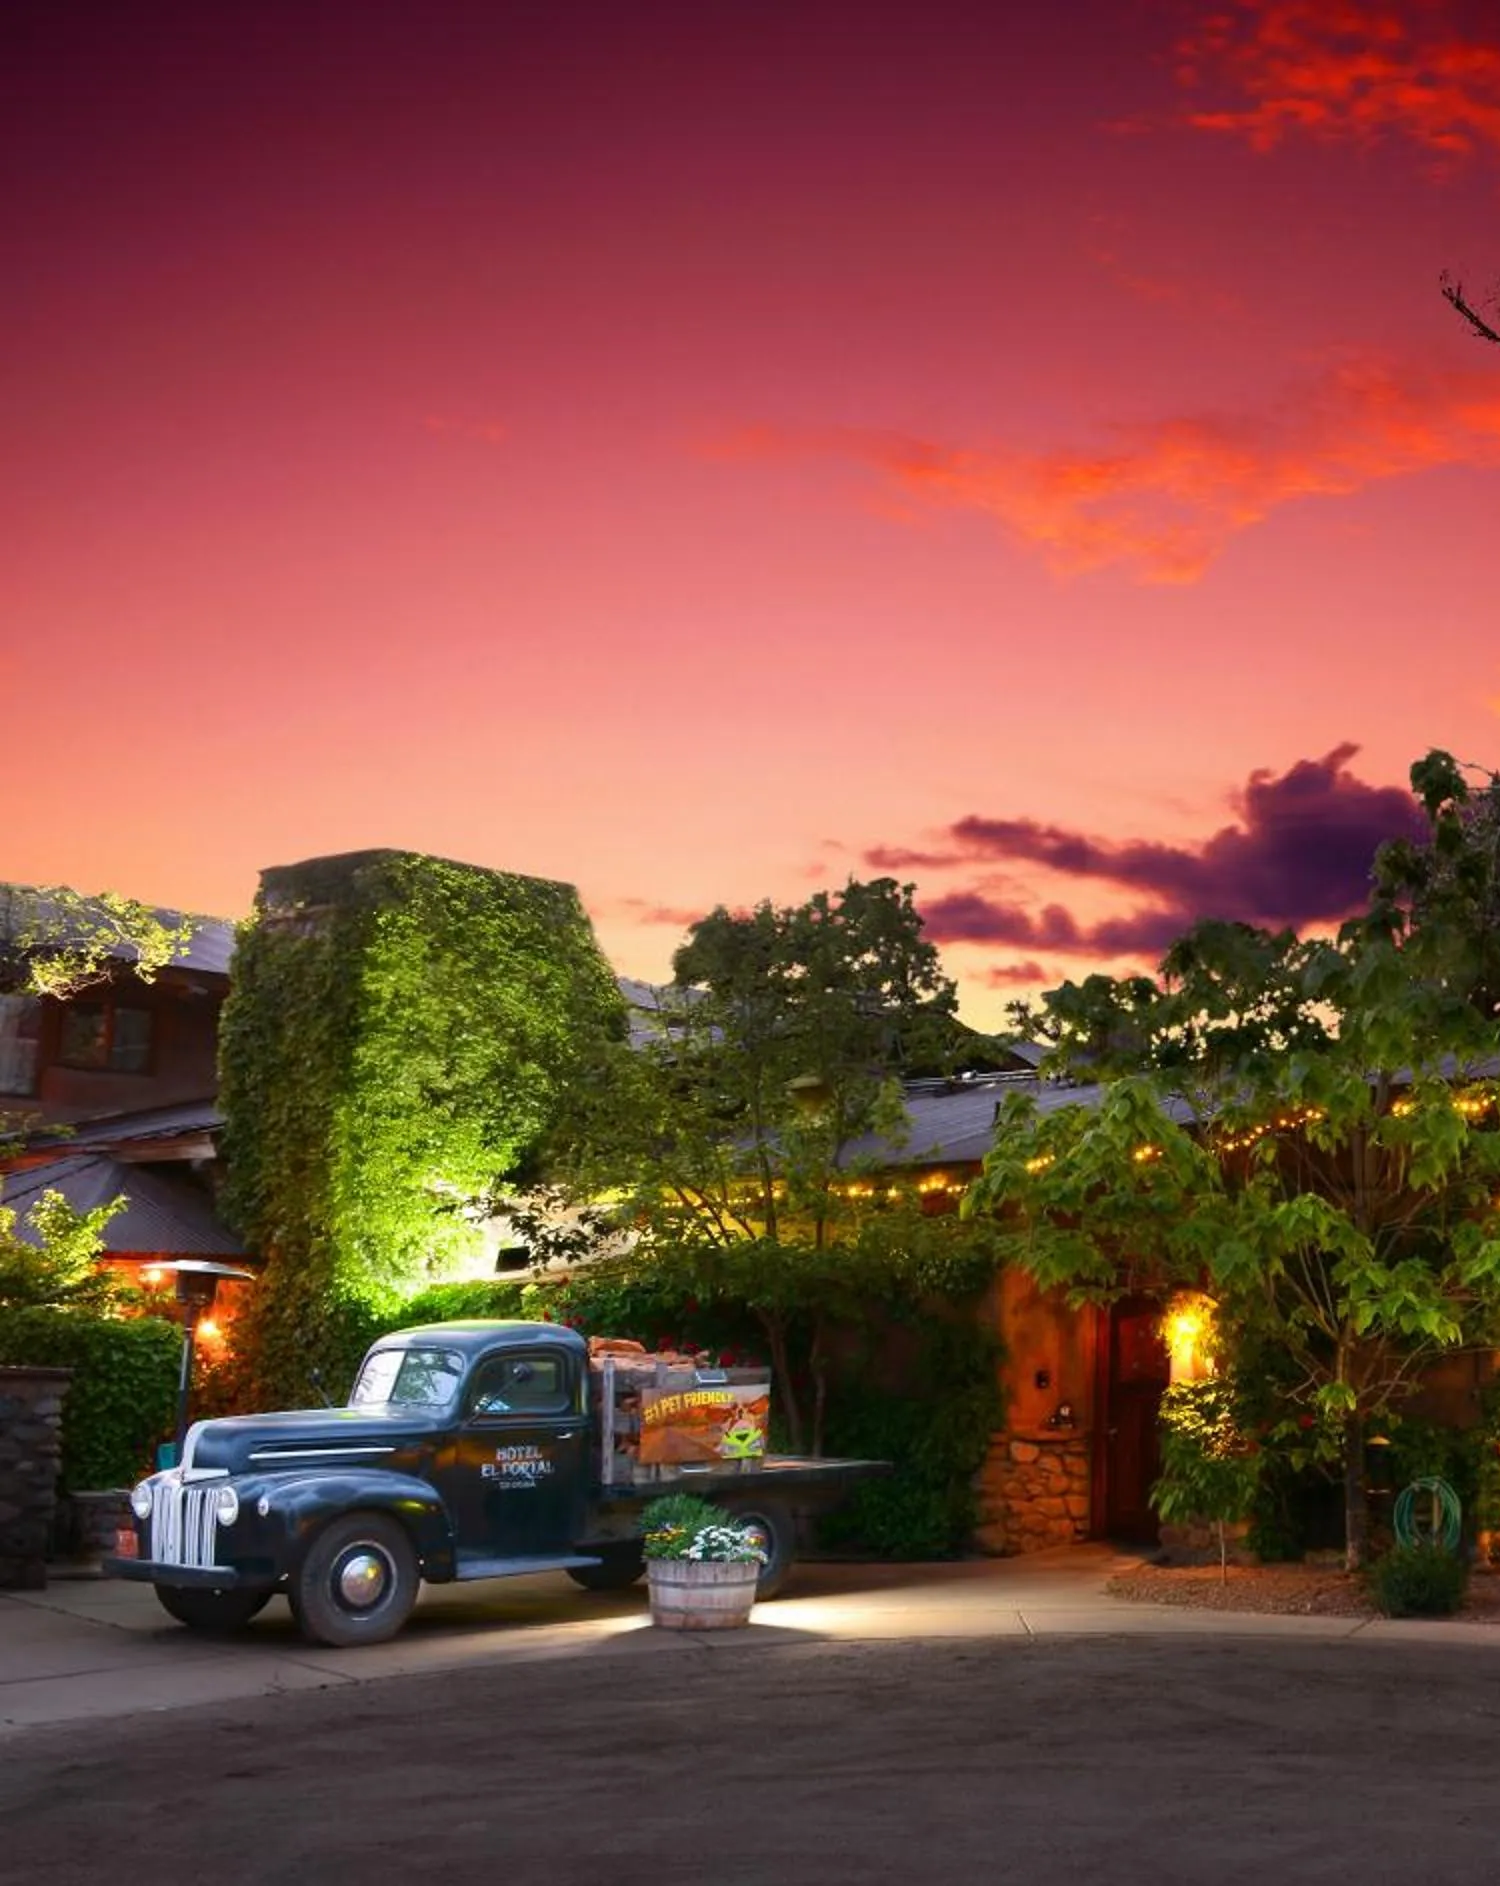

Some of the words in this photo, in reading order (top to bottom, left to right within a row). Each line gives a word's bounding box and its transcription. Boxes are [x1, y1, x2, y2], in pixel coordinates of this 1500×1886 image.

[660, 1395, 681, 1416] PET
[683, 1391, 736, 1408] FRIENDLY
[497, 1446, 543, 1460] HOTEL
[481, 1463, 500, 1477] EL
[502, 1459, 555, 1478] PORTAL
